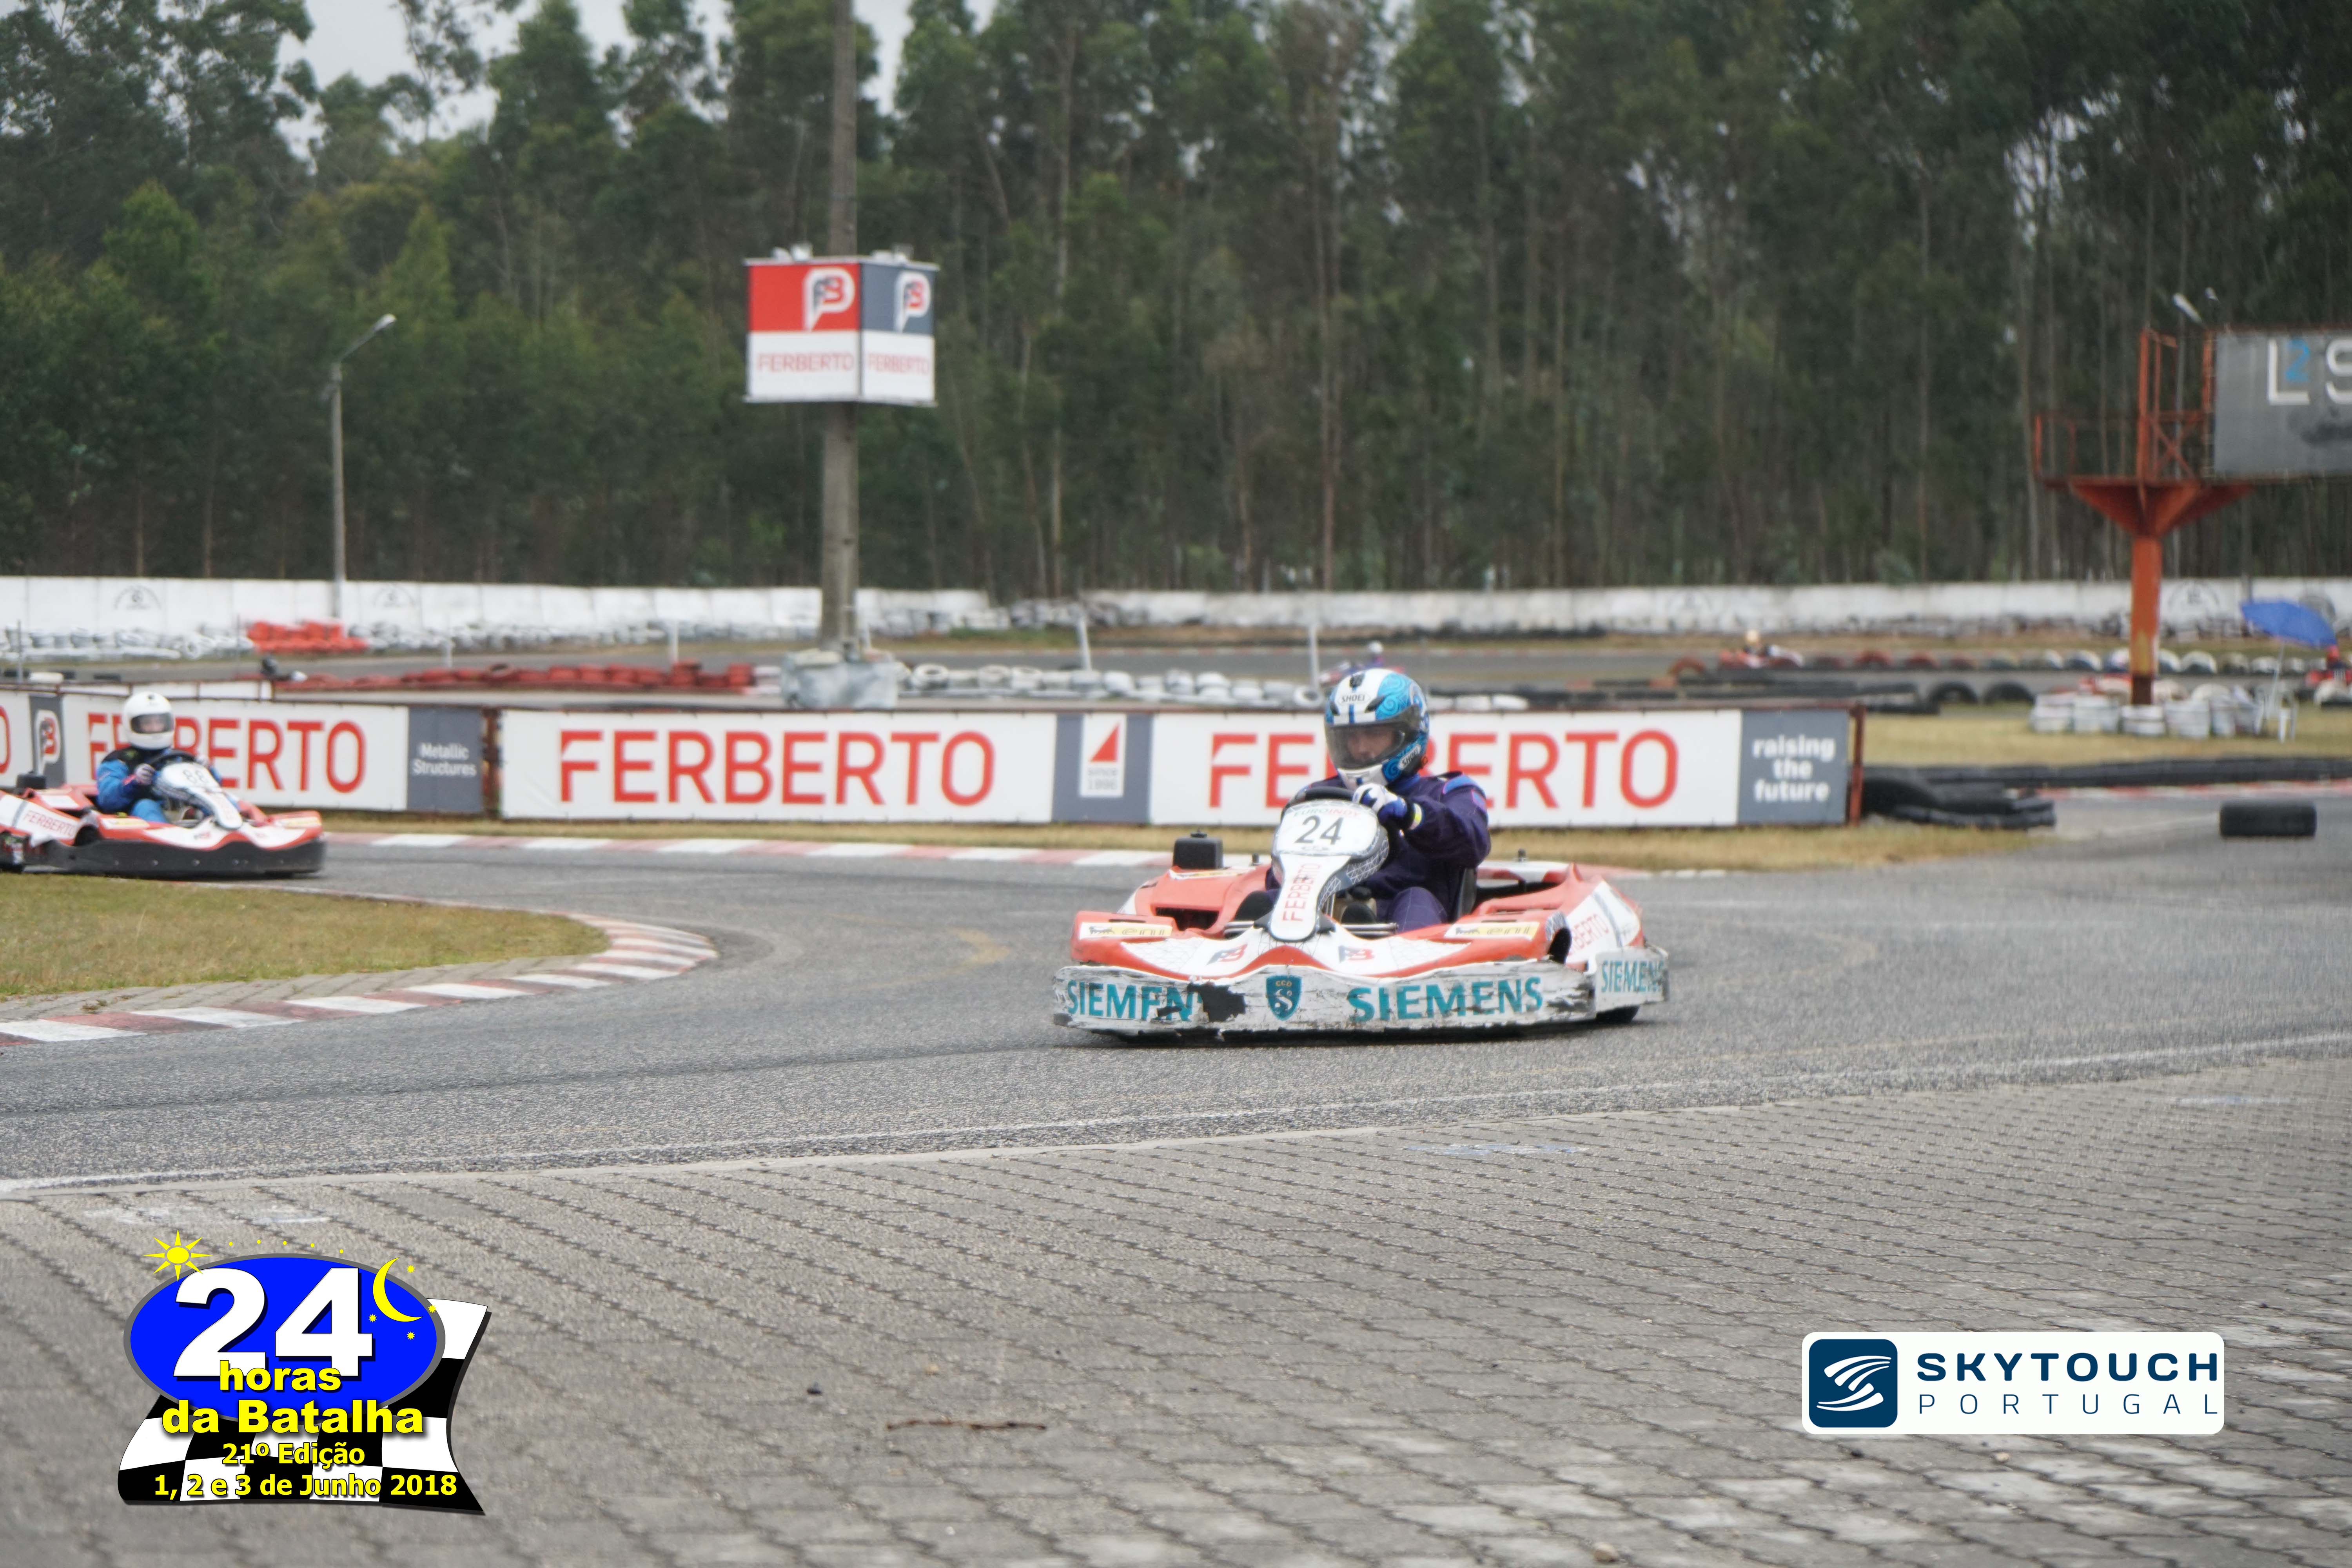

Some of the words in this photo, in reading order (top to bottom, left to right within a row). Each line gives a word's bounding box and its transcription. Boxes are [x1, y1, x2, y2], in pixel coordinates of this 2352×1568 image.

[759, 353, 854, 372] FERBERTO
[869, 354, 929, 375] FERBERTO
[1342, 694, 1365, 703] SHOEI
[88, 713, 366, 793] FBERTO
[421, 743, 469, 760] Metallic
[1401, 746, 1419, 766] SHOEI
[1753, 734, 1835, 762] raising
[414, 759, 477, 777] Structures
[561, 730, 995, 806] FERBERTO
[1209, 729, 1679, 810] FEERTO
[1773, 759, 1813, 779] the
[1754, 779, 1830, 802] future
[23, 810, 78, 836] FERBERTO
[1294, 815, 1344, 845] 24
[1282, 863, 1322, 922] FERBERTO
[1067, 980, 1203, 1022] SIEMEN
[1347, 976, 1543, 1022] SIEMENS
